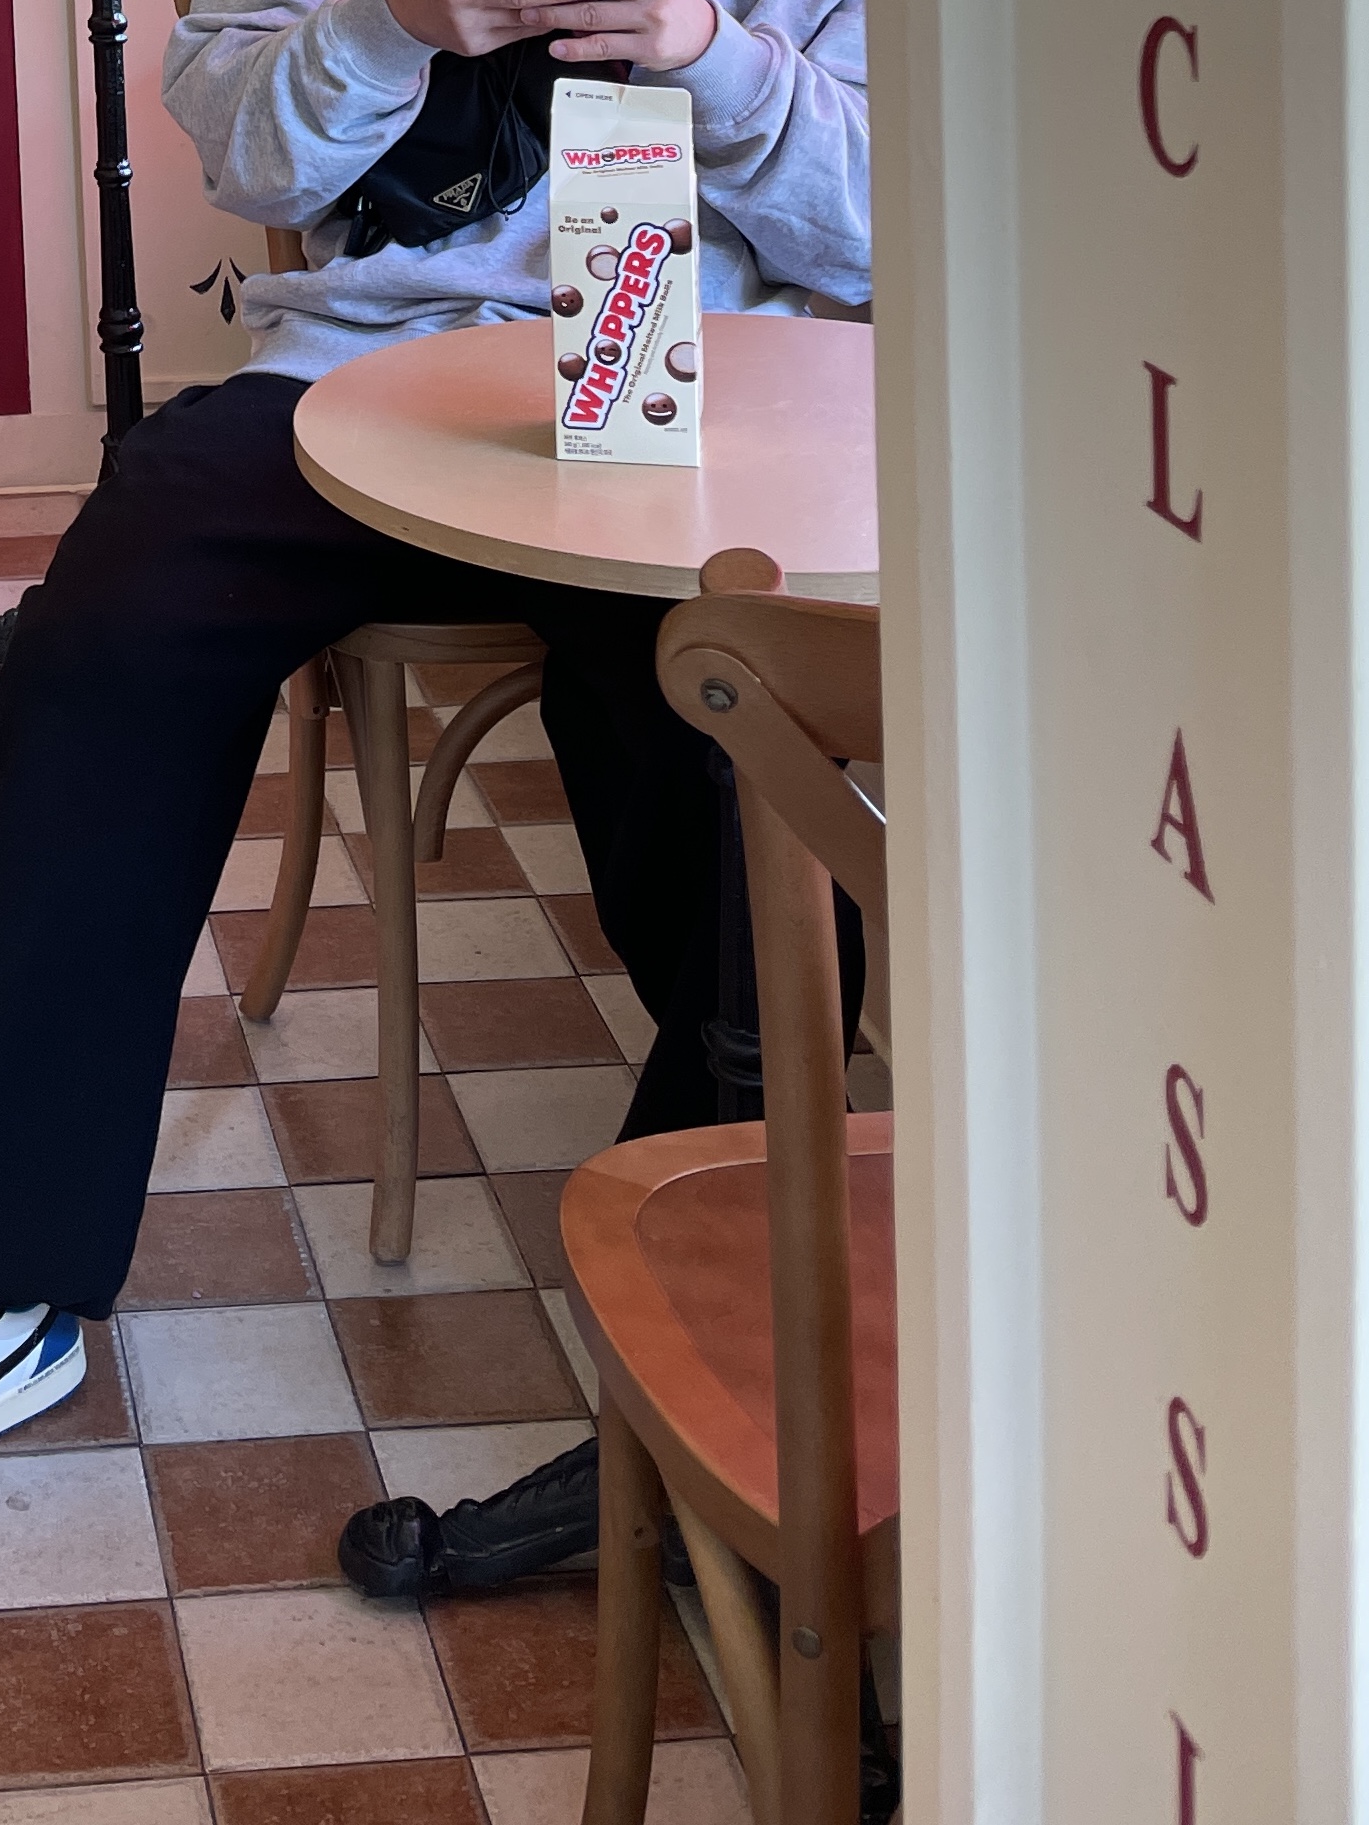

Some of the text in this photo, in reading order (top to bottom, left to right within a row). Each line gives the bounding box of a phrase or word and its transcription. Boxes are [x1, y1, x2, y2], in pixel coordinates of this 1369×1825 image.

[565, 146, 678, 166] WHOPPERS
[564, 215, 578, 224] Be
[558, 225, 602, 235] Original
[569, 229, 666, 424] WHOPPERS
[622, 391, 634, 404] The
[630, 355, 645, 389] Original
[642, 323, 658, 353] Malted
[654, 302, 665, 322] Milk
